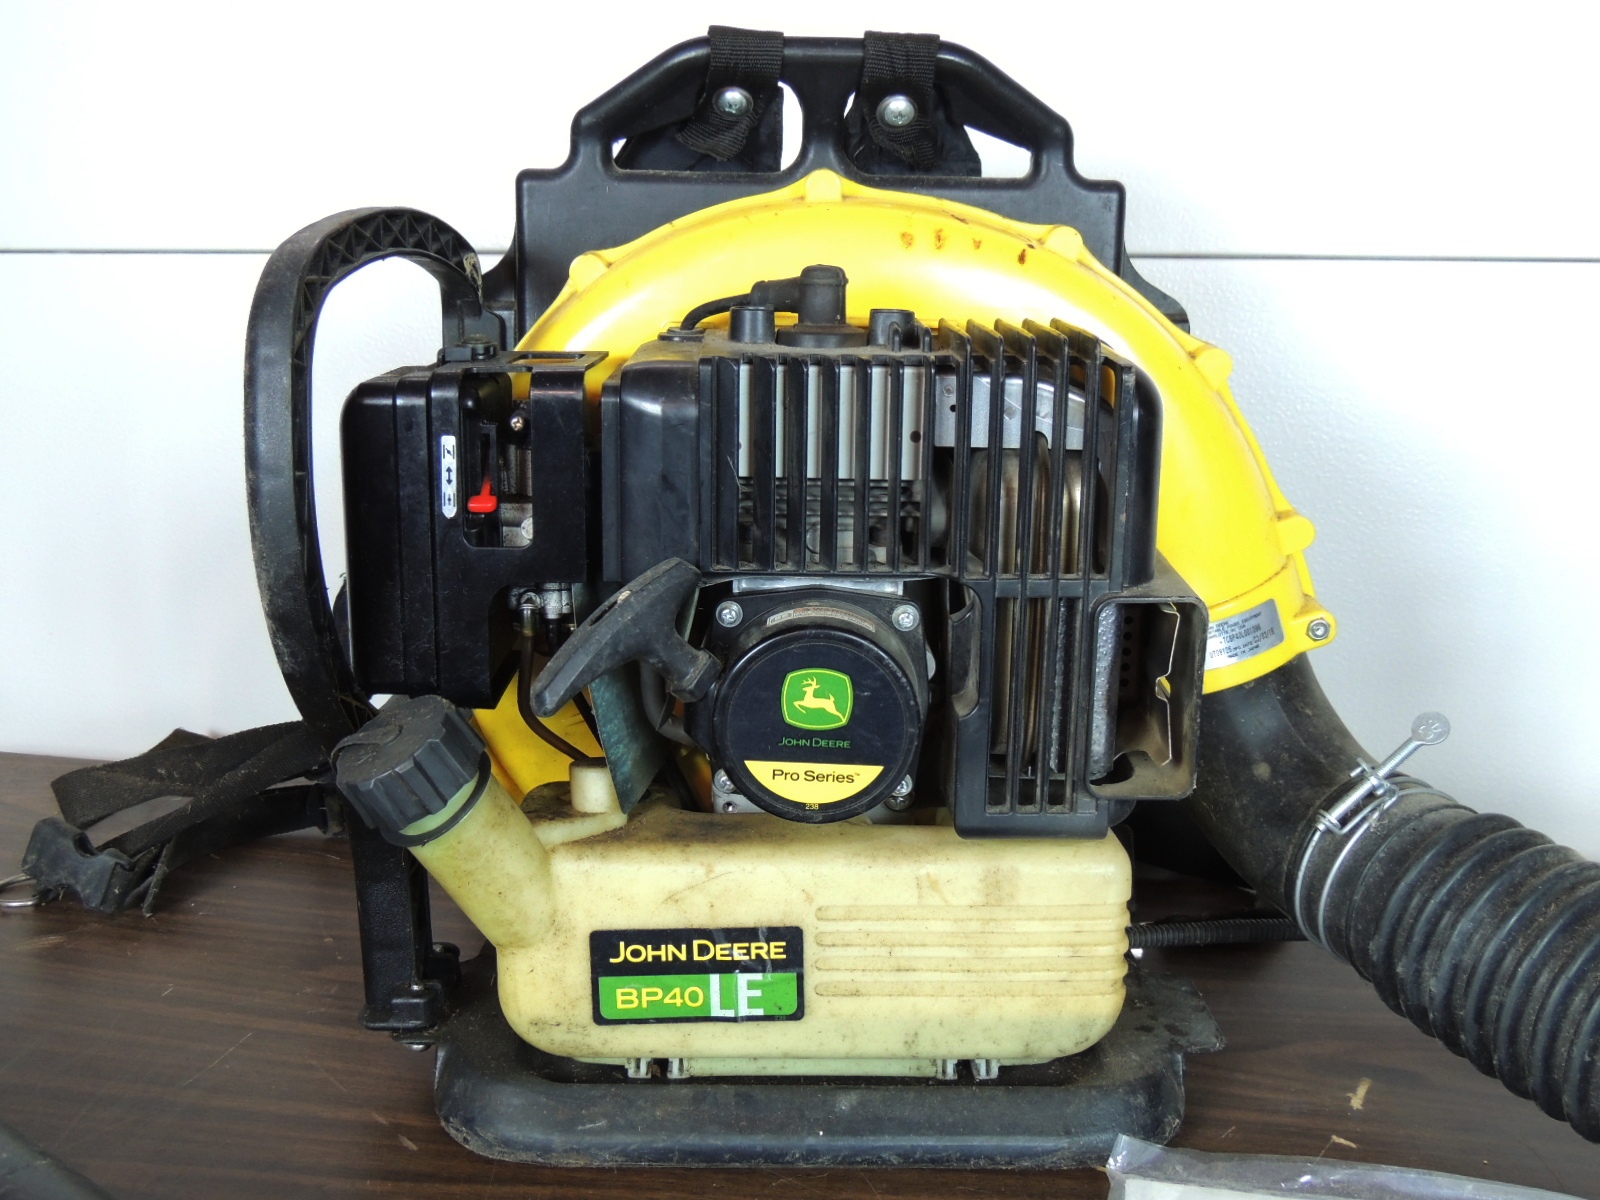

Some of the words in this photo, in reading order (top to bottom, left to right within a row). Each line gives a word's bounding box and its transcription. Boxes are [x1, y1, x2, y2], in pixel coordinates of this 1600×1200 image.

[778, 736, 810, 748] JOHN
[812, 738, 851, 749] DEERE
[772, 768, 800, 782] Pro
[609, 941, 687, 963] JOHN
[692, 940, 787, 961] DEERE
[616, 986, 705, 1010] BP40
[710, 972, 764, 1018] LE
